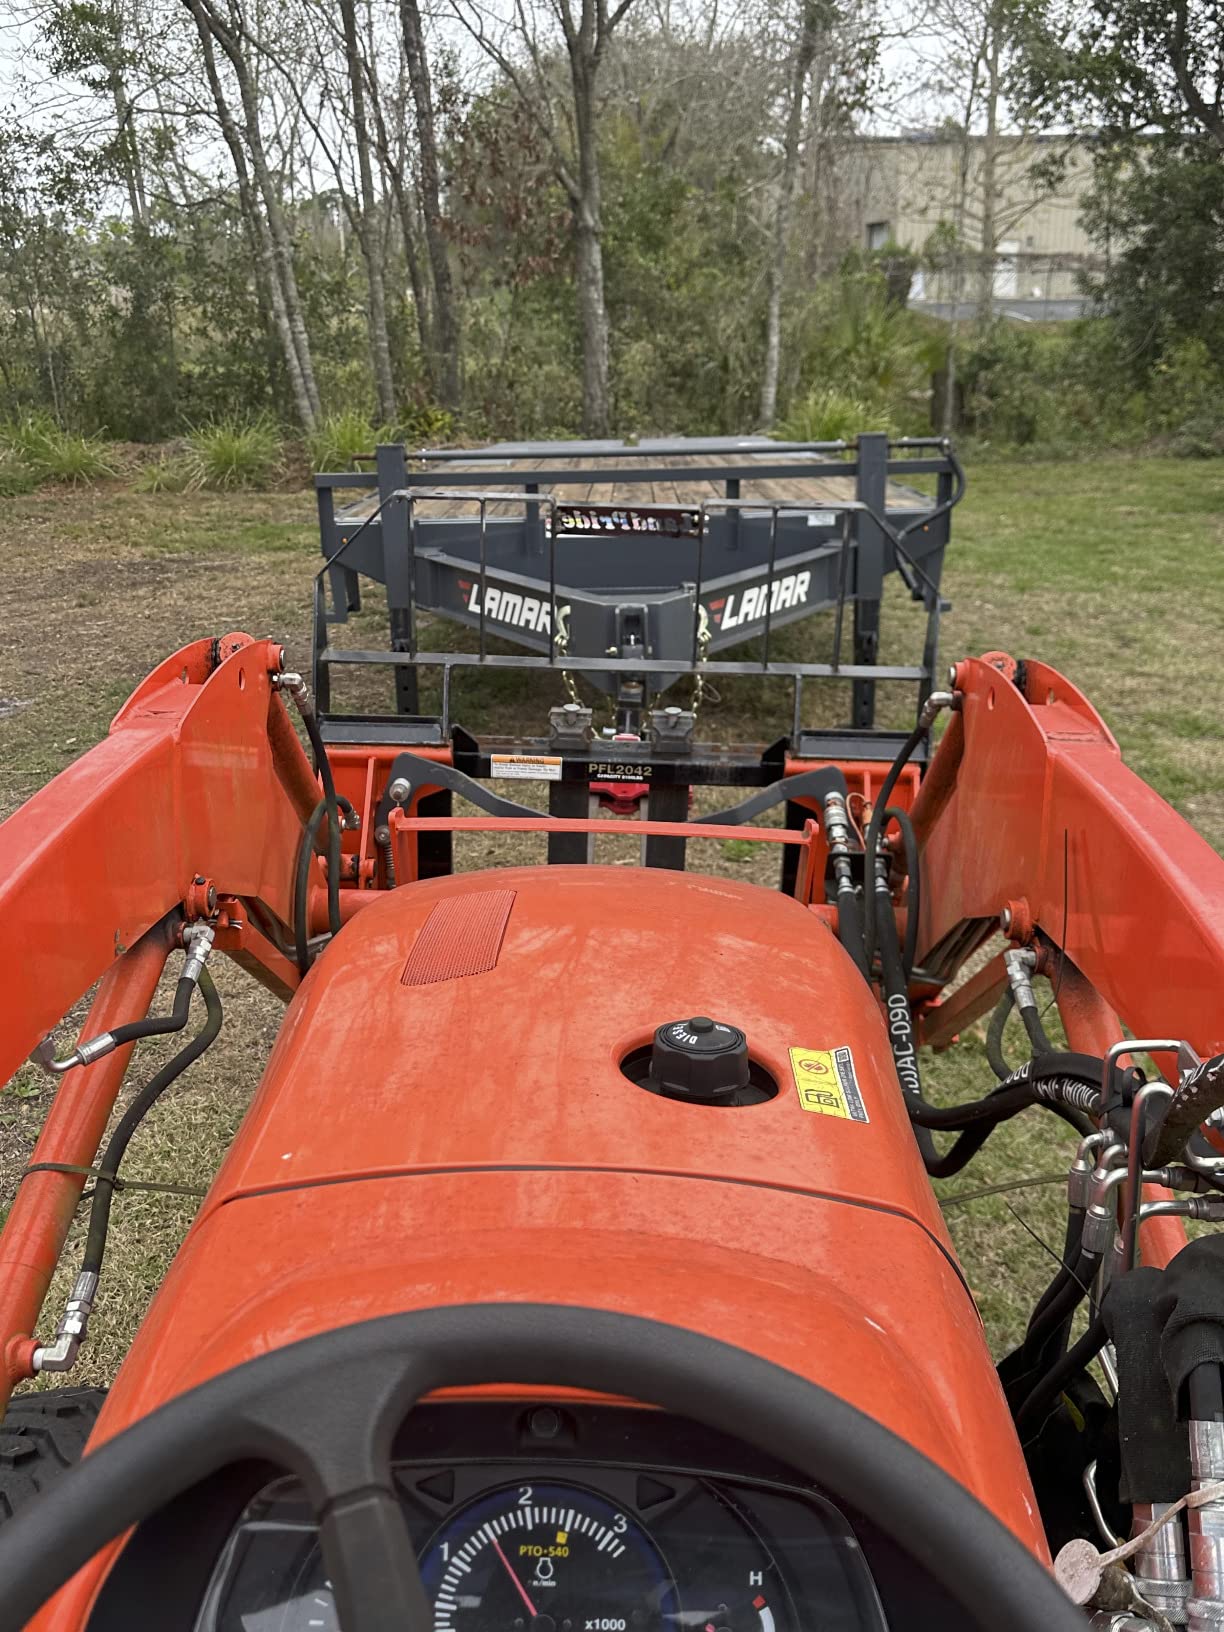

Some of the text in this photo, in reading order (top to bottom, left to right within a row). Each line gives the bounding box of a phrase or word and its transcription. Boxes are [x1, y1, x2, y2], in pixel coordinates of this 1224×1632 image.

[468, 583, 557, 635] LAMAR
[720, 570, 811, 631] LAMAR
[588, 763, 652, 776] PFL2042
[672, 1022, 698, 1044] DIESEL
[518, 1486, 533, 1504] 2
[613, 1514, 628, 1533] 3
[439, 1541, 449, 1561] 1
[749, 1570, 763, 1586] H
[584, 1618, 626, 1631] x1000
